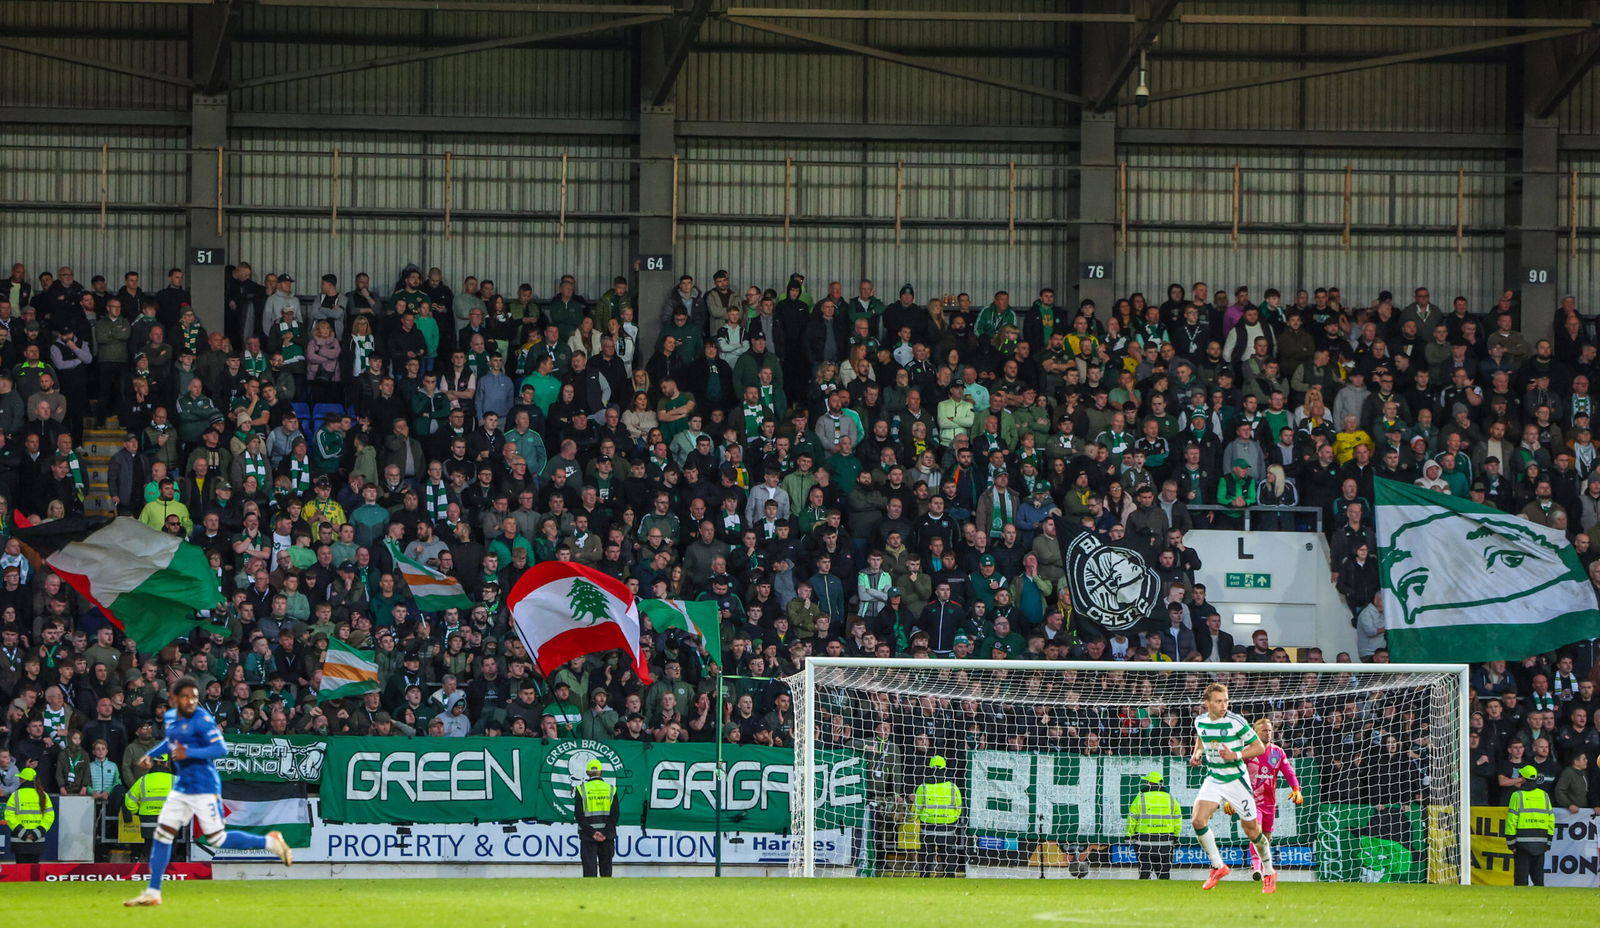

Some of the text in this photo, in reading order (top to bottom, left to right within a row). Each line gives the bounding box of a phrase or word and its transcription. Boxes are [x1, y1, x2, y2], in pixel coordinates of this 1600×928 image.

[197, 250, 212, 264] 51
[647, 257, 664, 270] 64
[1087, 265, 1104, 279] 76
[1529, 269, 1547, 283] 90
[1237, 536, 1254, 560] L
[546, 739, 624, 772] GREEN BRIGADE
[346, 748, 523, 802] GREEN
[208, 802, 216, 818] 3
[1241, 799, 1250, 813] 2
[328, 833, 718, 858] PROPERTY & CONSUCTION
[752, 836, 836, 851] Hares
[46, 873, 188, 882] OFFICIAL SPRIT
